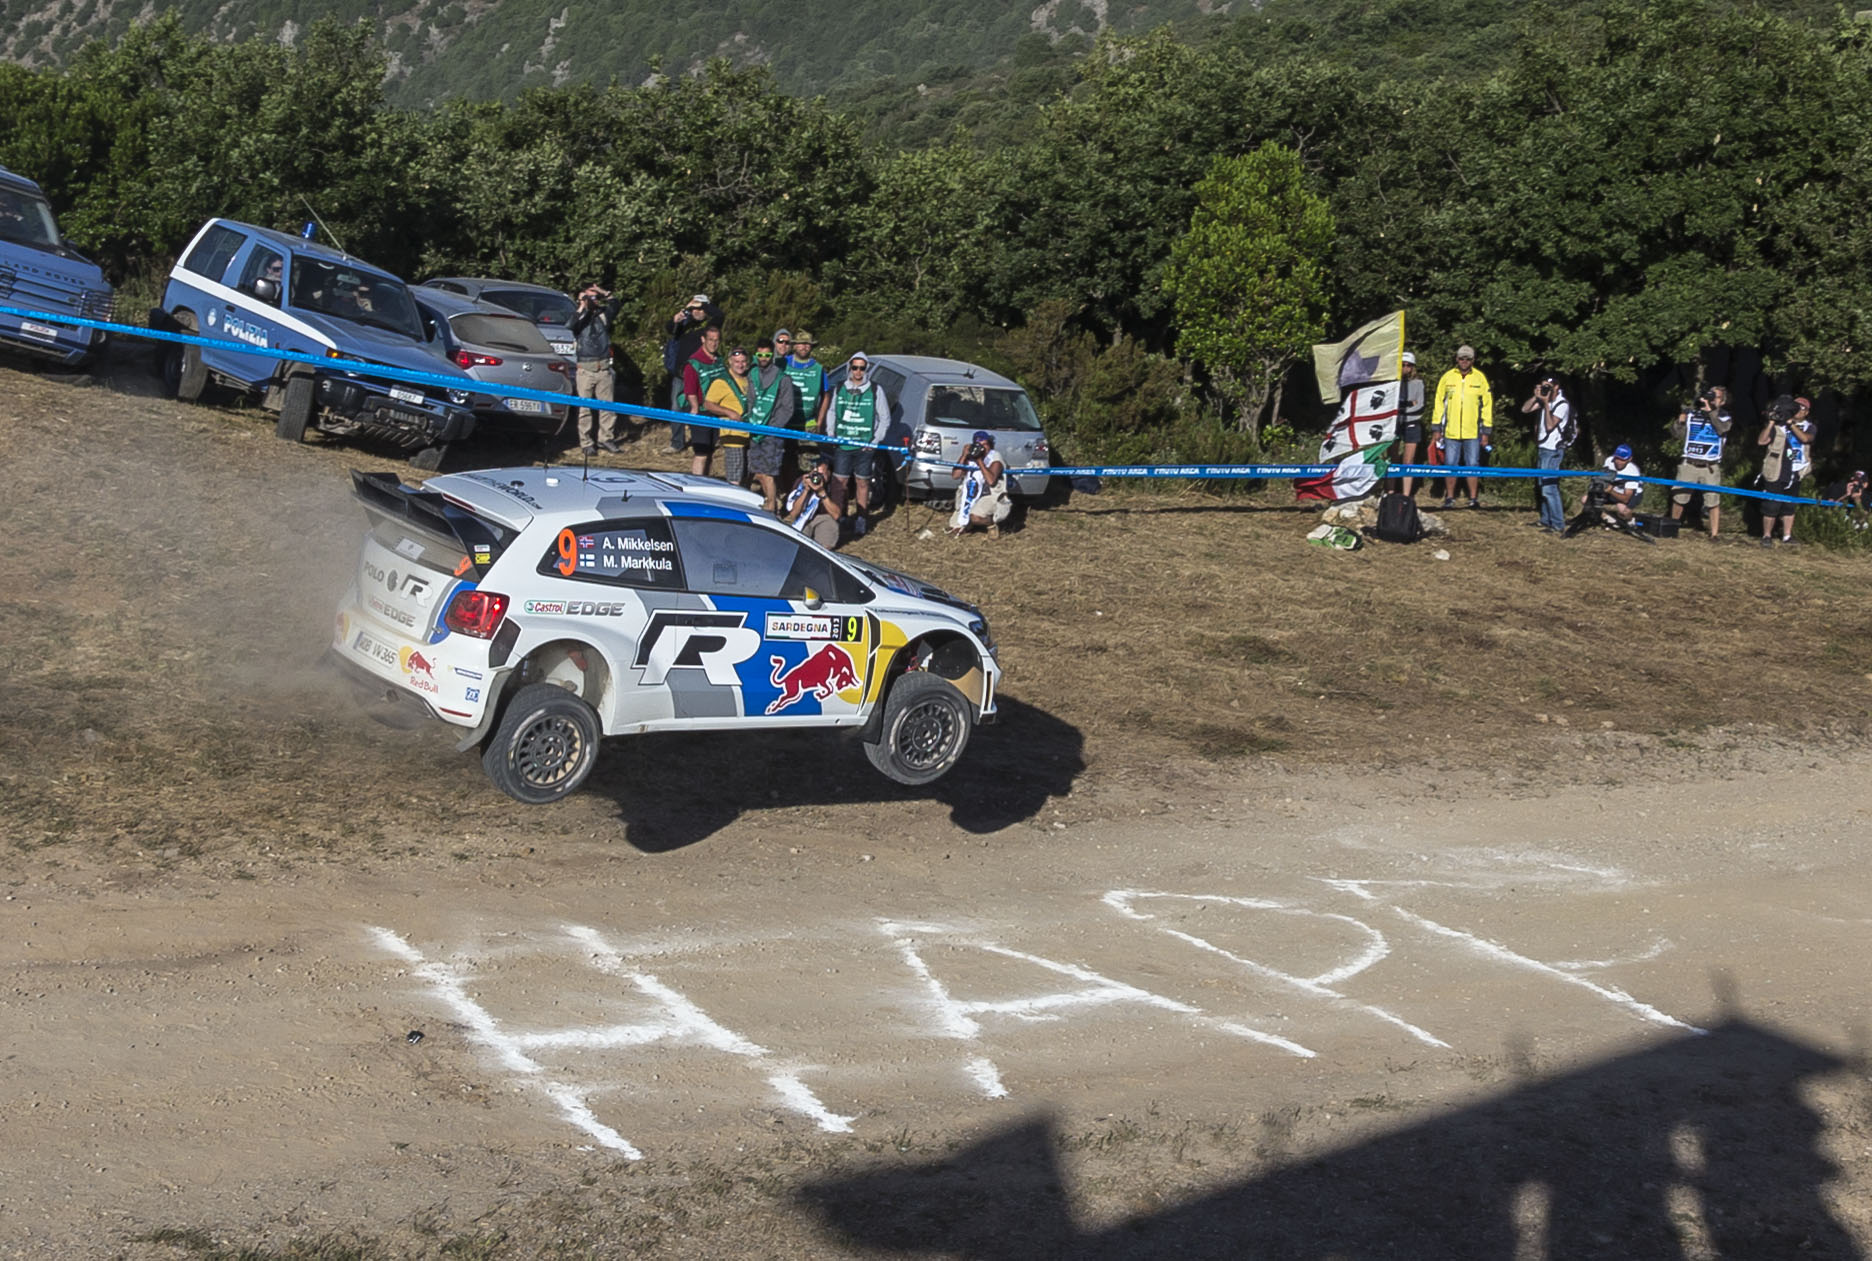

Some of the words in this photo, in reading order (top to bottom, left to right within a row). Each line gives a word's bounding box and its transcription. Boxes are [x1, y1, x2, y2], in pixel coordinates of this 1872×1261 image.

[223, 313, 269, 348] POLIZIA
[559, 528, 577, 576] 9
[602, 538, 614, 551] A.
[617, 537, 674, 552] Mikkelsen
[602, 556, 618, 570] M.
[621, 556, 673, 571] Markkula
[364, 561, 385, 583] POLO
[400, 573, 433, 609] R
[383, 603, 416, 628] EDGE
[534, 600, 564, 614] Castrol
[566, 601, 625, 617] EDGE
[771, 620, 828, 633] SARDEGNA
[832, 617, 840, 639] 2013
[847, 616, 858, 642] 9
[631, 609, 761, 686] R
